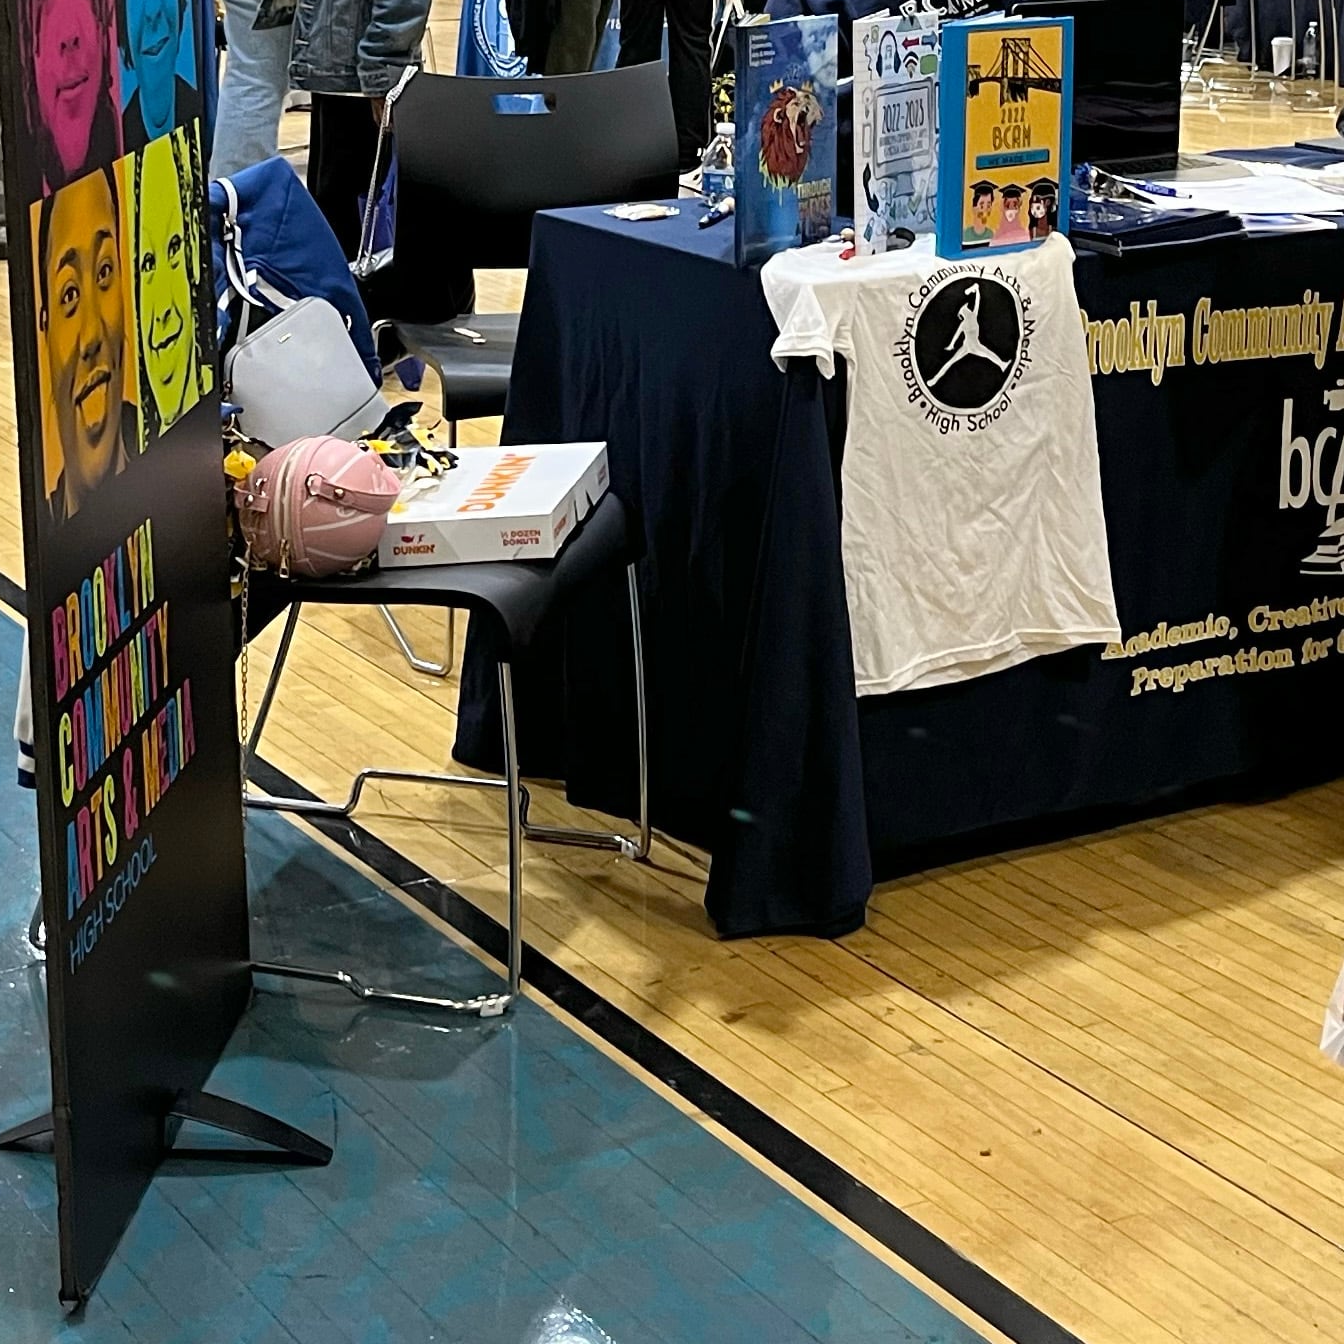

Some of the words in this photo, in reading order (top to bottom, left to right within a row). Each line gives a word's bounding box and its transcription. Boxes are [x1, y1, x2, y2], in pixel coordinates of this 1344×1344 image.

[881, 97, 925, 135] 2022-2023
[992, 122, 1032, 151] BCAM
[1001, 106, 1026, 124] 2022
[908, 263, 986, 309] Community
[993, 266, 1021, 295] Arts
[1021, 296, 1032, 313] &
[893, 317, 924, 403] Brooklyn
[1014, 319, 1037, 382] Media
[1082, 300, 1186, 386] rooklyn
[1192, 290, 1334, 370] Community
[924, 406, 960, 435] High
[967, 391, 1012, 432] School
[392, 543, 436, 556] DUNKIN'
[502, 537, 540, 546] DONUTS
[510, 529, 541, 539] DOZEN
[52, 518, 155, 703] BROOKLYN
[1102, 613, 1239, 660] Academic,
[1130, 648, 1293, 697] Preparation
[1301, 635, 1334, 665] for
[58, 600, 169, 808] COMMUNITY
[67, 773, 118, 921] ARTS
[122, 747, 139, 840] &
[142, 678, 196, 817] MEDIA
[69, 903, 105, 975] HIGH
[105, 832, 159, 925] SCHOOL
